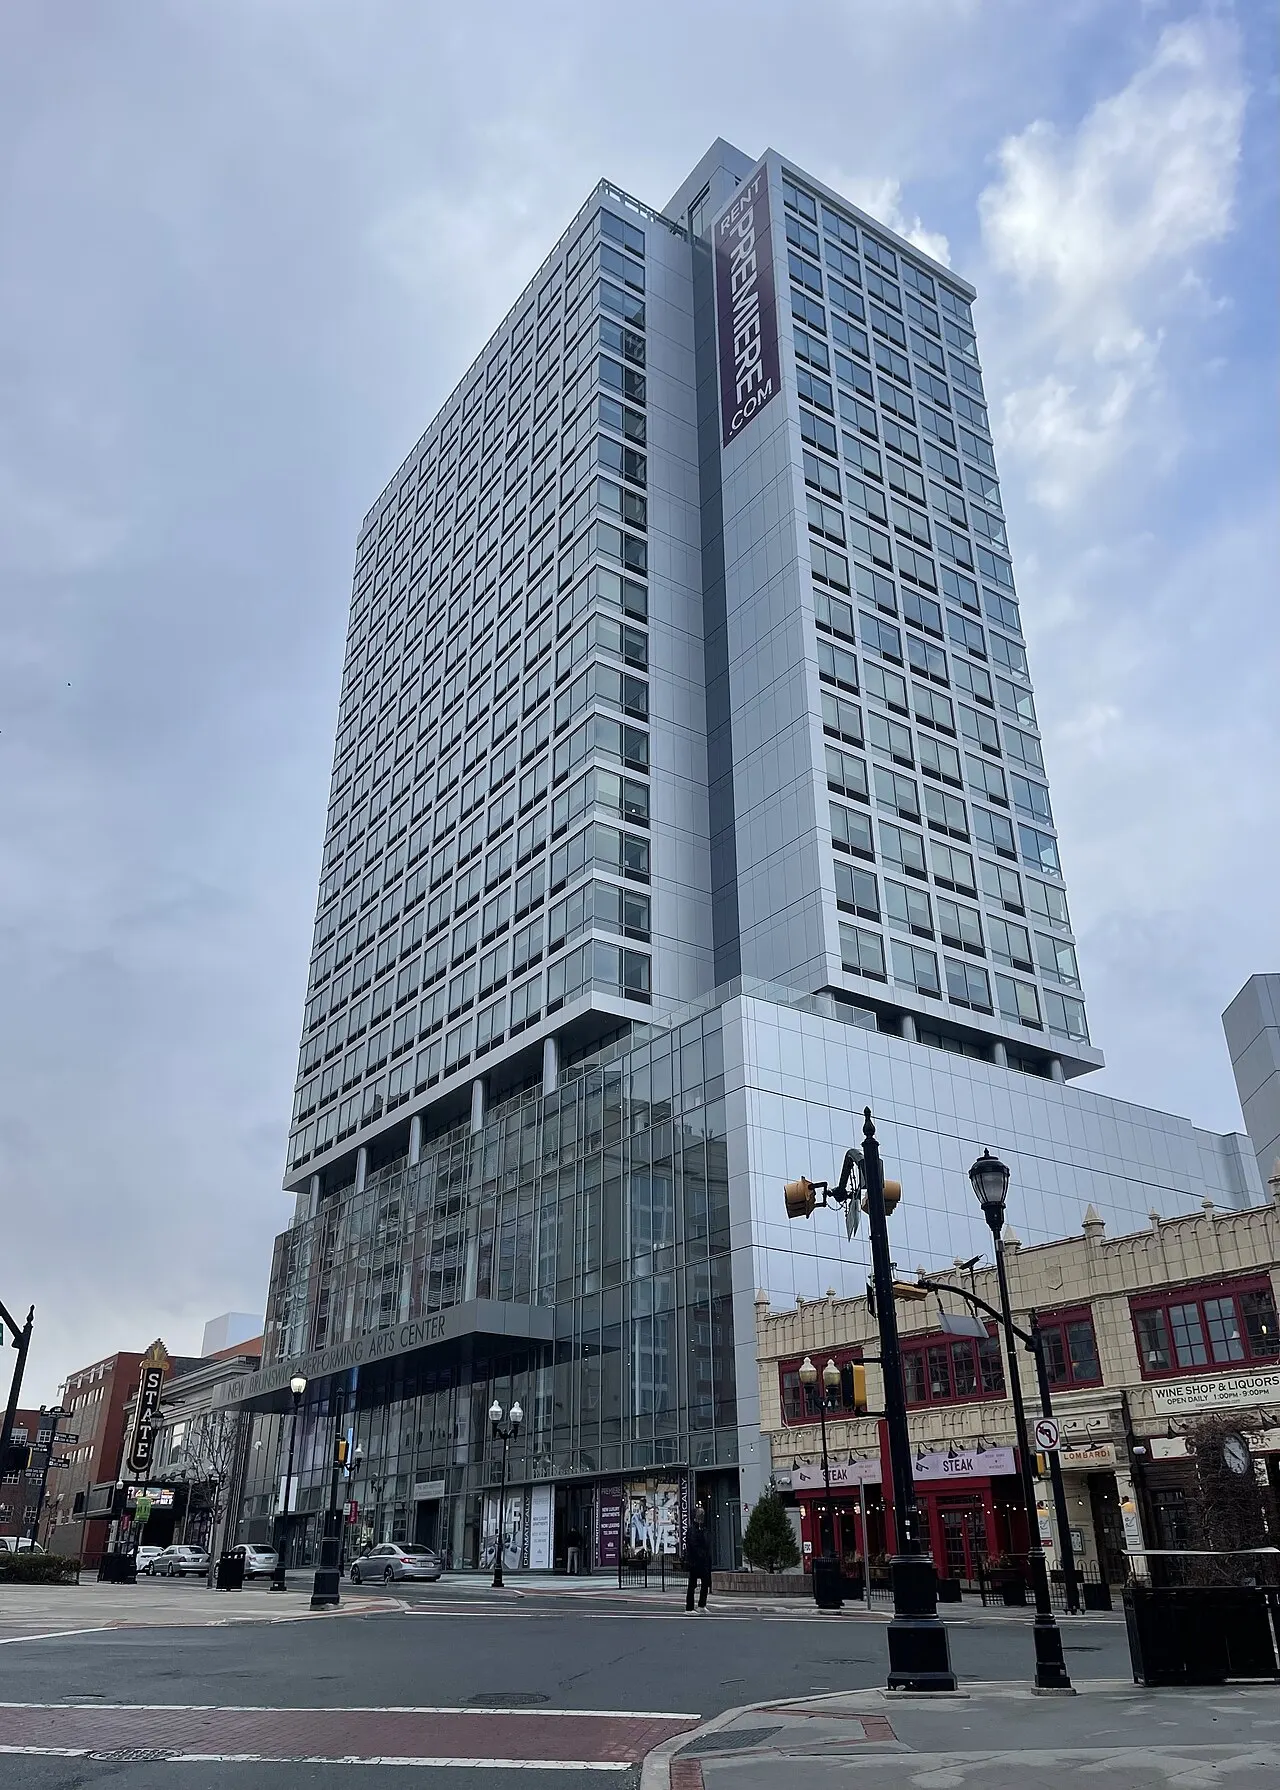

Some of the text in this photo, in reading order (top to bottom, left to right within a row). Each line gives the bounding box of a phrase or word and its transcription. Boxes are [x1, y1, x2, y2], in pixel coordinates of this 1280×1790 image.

[720, 174, 762, 237] RENT
[729, 205, 765, 405] PREMIERE
[728, 378, 772, 436] .COM
[227, 1315, 446, 1401] NEW BRUNSWICK PERFORMING ARTS CENTER
[1156, 1387, 1183, 1398] WINE
[1185, 1383, 1216, 1395] SHOP
[1228, 1376, 1280, 1390] LIQUORS
[136, 1373, 160, 1458] STATE
[1167, 1397, 1187, 1405] OPEN
[1188, 1394, 1208, 1403] DAILY
[943, 1459, 974, 1472] STEAK
[1063, 1450, 1111, 1460] LOMBARDI
[523, 1496, 531, 1566] DRAMATICALLY
